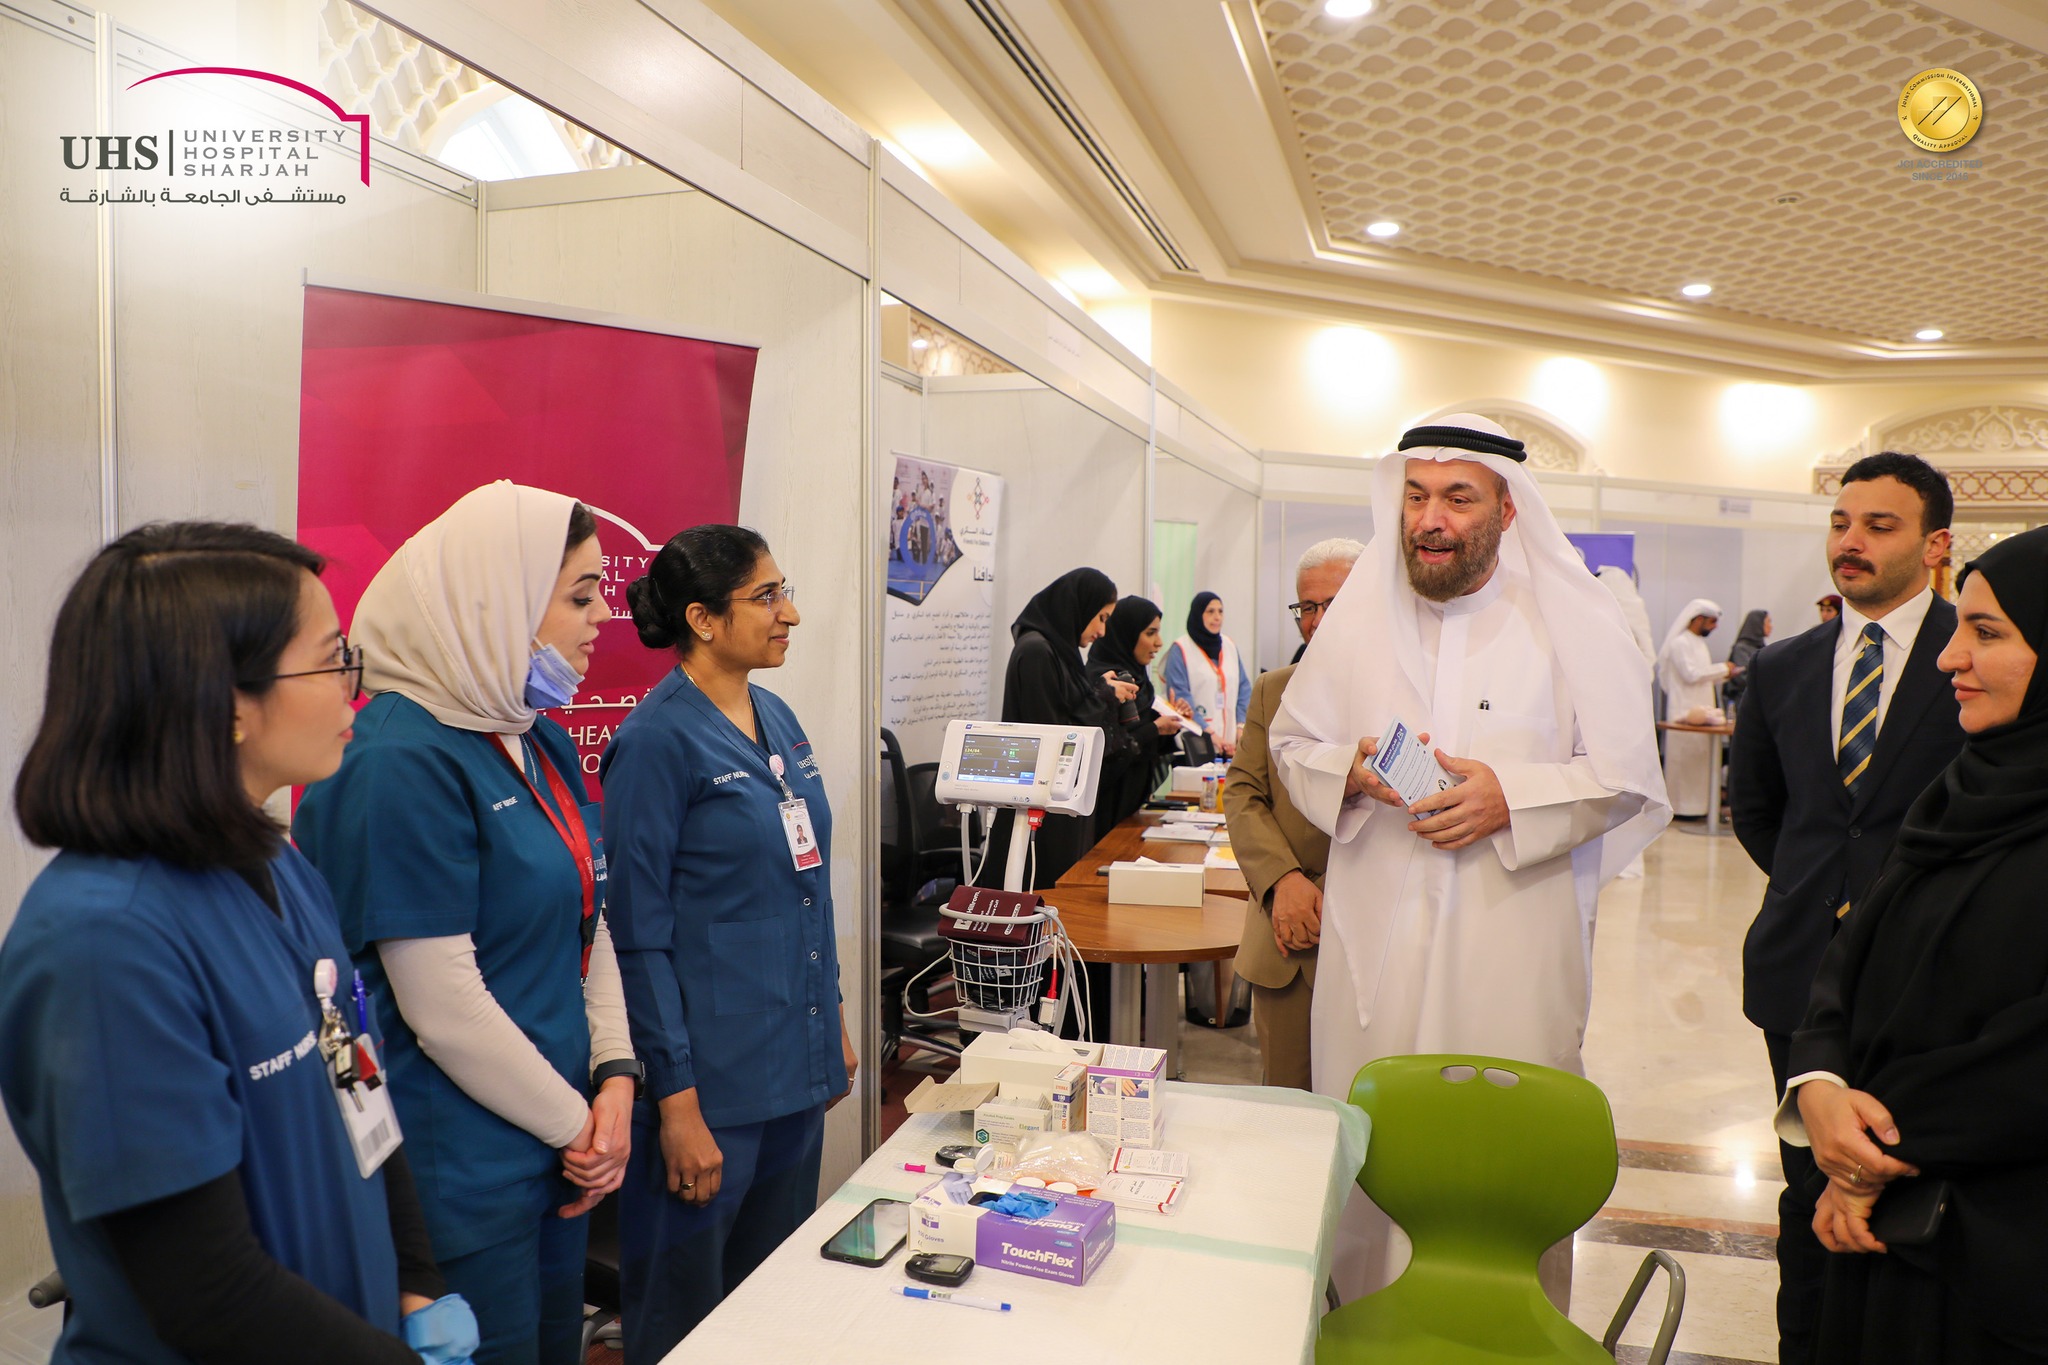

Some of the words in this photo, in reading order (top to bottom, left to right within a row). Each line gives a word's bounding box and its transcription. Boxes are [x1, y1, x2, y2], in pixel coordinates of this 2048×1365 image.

[713, 773, 732, 785] STAFF
[249, 1049, 294, 1080] STAFF
[925, 1233, 945, 1243] Gloves
[1001, 1241, 1075, 1269] TouchFlex
[1001, 1259, 1015, 1267] Nitrile
[1015, 1262, 1044, 1273] Powder-Free
[1044, 1268, 1058, 1276] Exam
[1058, 1271, 1075, 1279] Gloves
